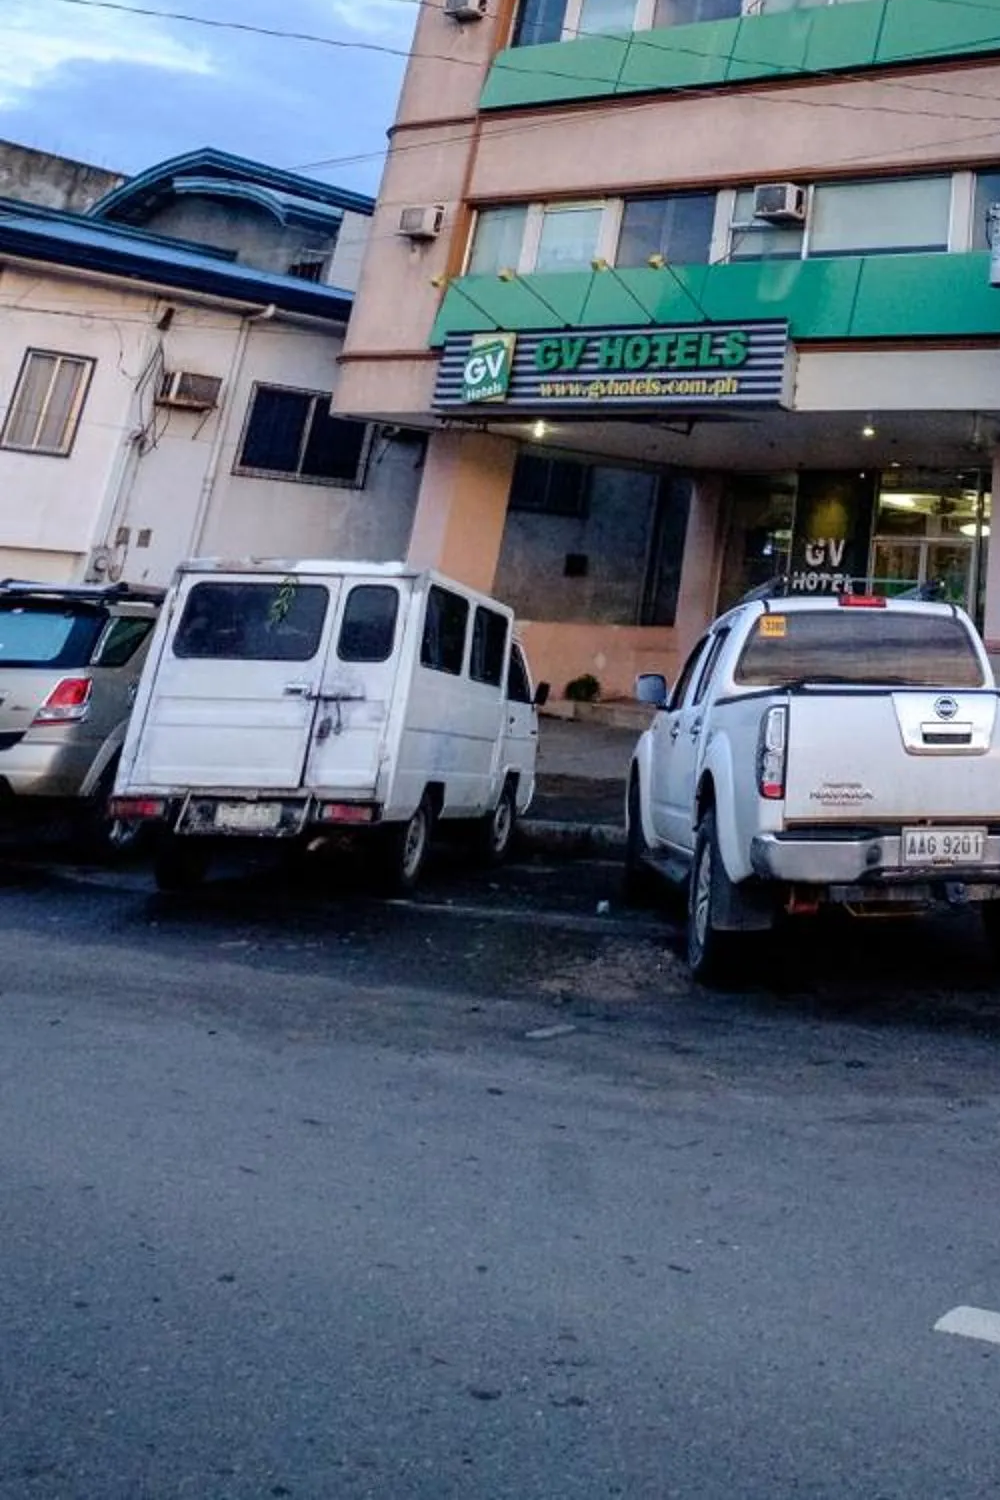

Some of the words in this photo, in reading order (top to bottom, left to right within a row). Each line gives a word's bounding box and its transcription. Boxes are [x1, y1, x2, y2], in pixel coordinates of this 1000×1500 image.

[536, 337, 586, 371] GV
[599, 331, 749, 369] HOTELS
[464, 350, 505, 385] GV
[540, 376, 739, 397] www.gvhotels.com.ph
[806, 538, 846, 567] GV
[792, 571, 853, 594] HOTEL
[908, 836, 936, 855] AAG
[944, 835, 979, 855] 9201
